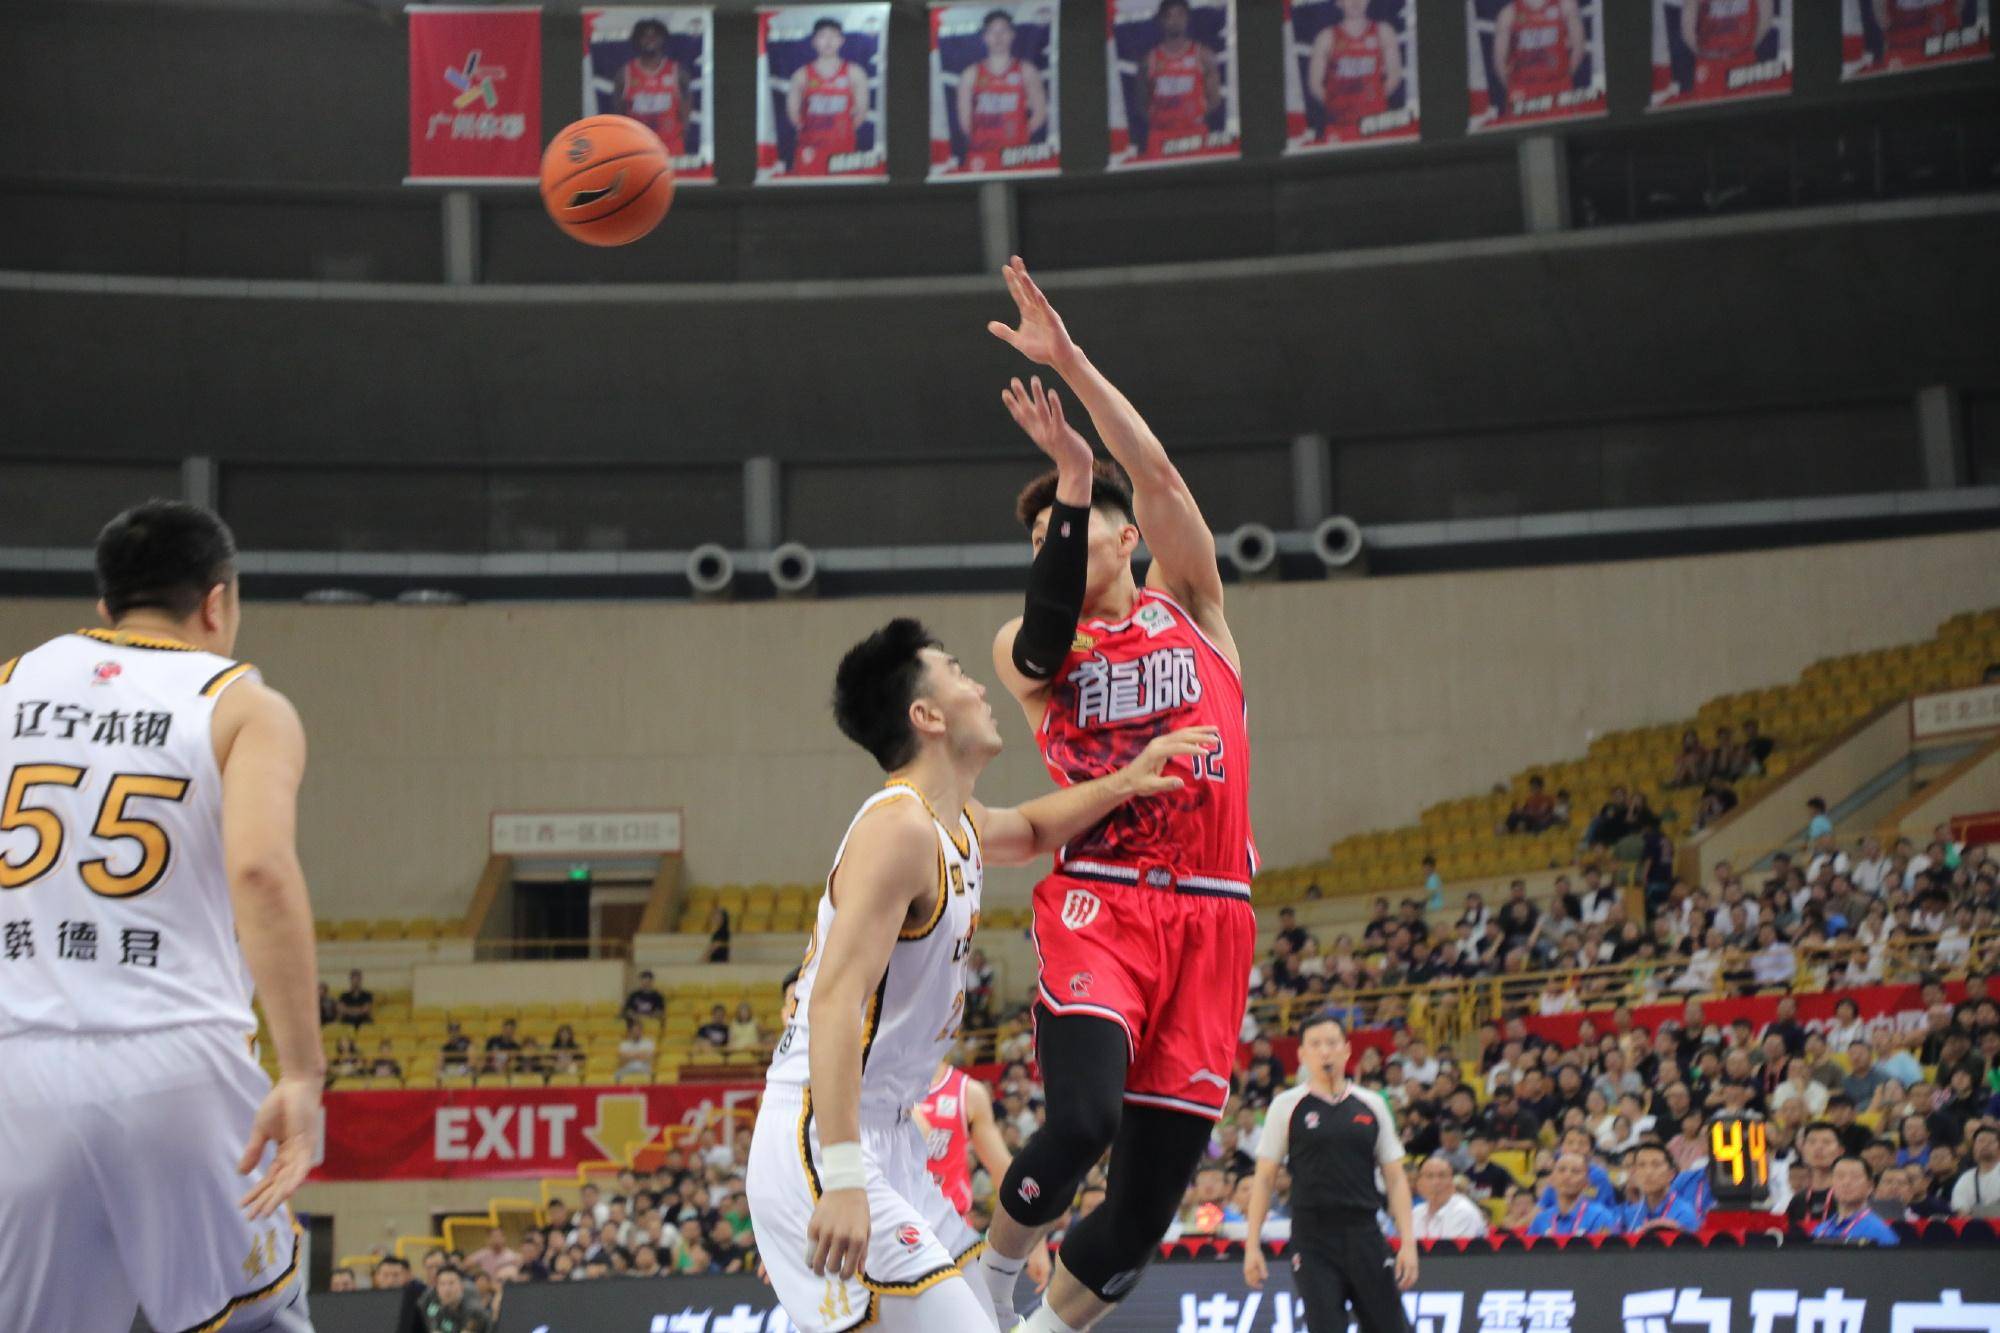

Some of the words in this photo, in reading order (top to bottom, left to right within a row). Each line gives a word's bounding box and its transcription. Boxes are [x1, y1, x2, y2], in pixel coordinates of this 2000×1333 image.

[14, 701, 174, 748] 辽宁本钢
[0, 763, 192, 898] 55
[4, 919, 161, 968] 韩德君
[434, 1104, 578, 1161] EXIT
[1712, 1120, 1768, 1186] 44
